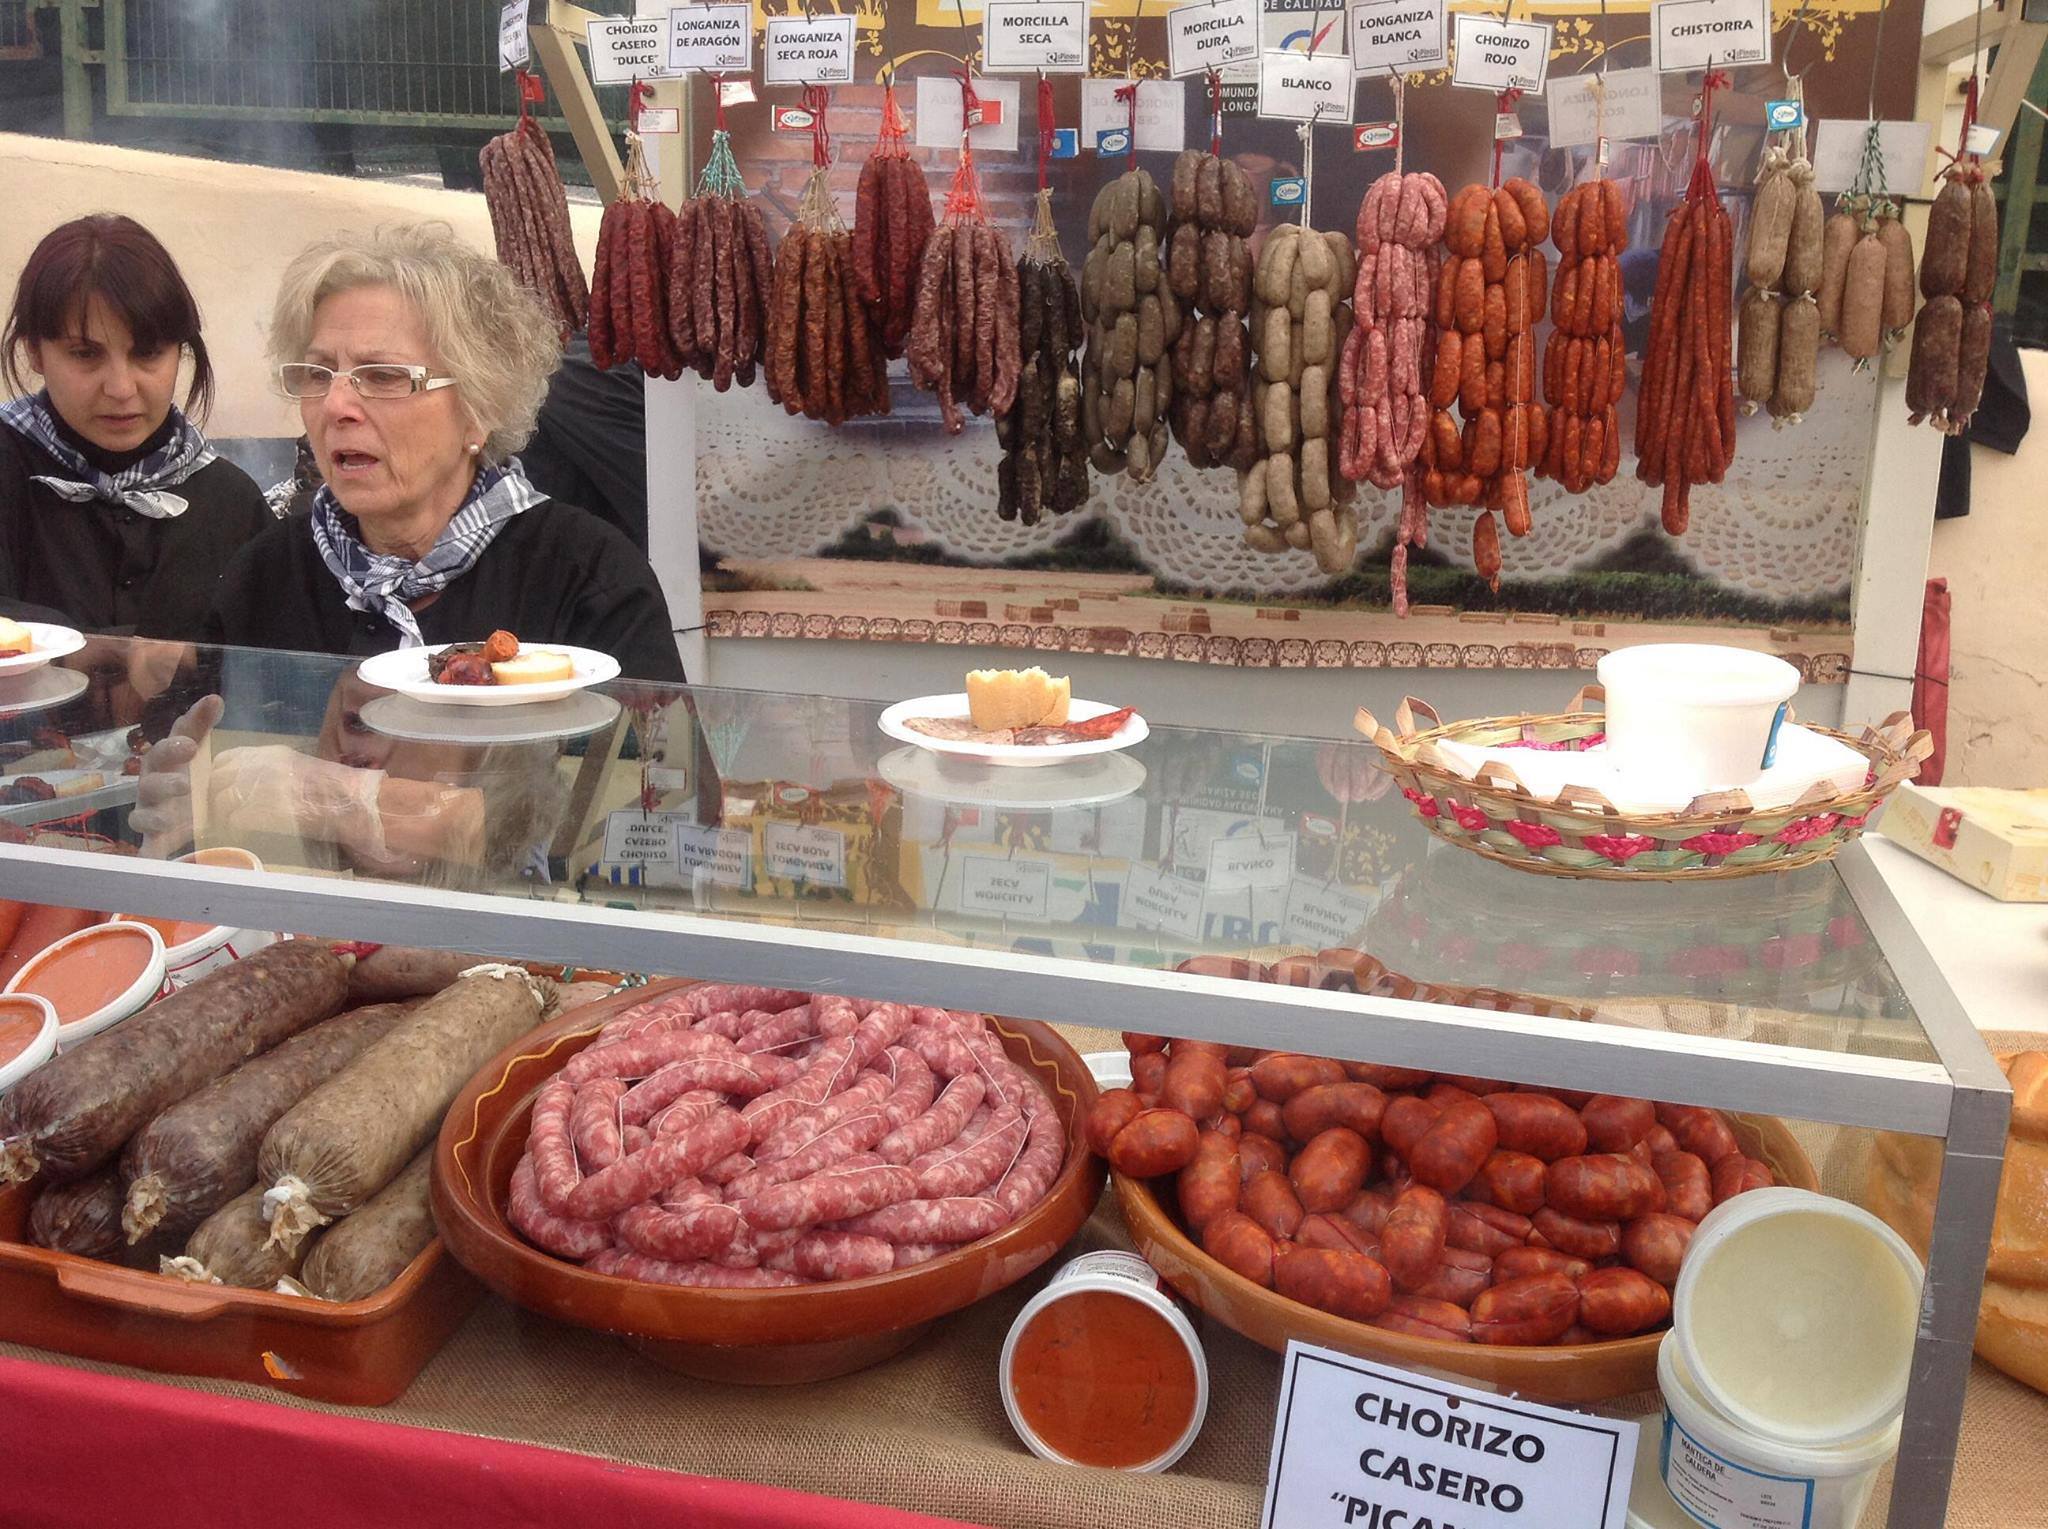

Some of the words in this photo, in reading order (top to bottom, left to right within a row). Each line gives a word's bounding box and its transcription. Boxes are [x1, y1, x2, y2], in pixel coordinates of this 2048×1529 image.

[677, 20, 741, 31] LONGANIZA
[1002, 16, 1069, 27] MORCILLA
[1183, 15, 1245, 36] MORCILLA
[1360, 10, 1434, 29] LONGANIZA
[606, 24, 658, 35] CHORIZO
[1671, 19, 1754, 37] CHISTORRA
[676, 37, 690, 47] DE
[691, 34, 740, 47] ARAGÓN
[774, 32, 843, 44] LONGANIZA
[1019, 33, 1052, 44] SECA
[1196, 35, 1231, 50] DURA
[1372, 29, 1422, 45] BLANCA
[1475, 34, 1530, 49] CHORIZO
[611, 39, 657, 51] CASERO
[777, 50, 806, 60] SECA
[808, 49, 838, 59] ROJA
[1484, 53, 1517, 66] ROJO
[1281, 77, 1332, 91] BLANCO
[1207, 87, 1259, 98] CMUNID
[1355, 1392, 1545, 1463] CHORIZO
[1681, 1438, 1713, 1469] MANTECA
[1714, 1461, 1726, 1474] DE
[1684, 1454, 1717, 1481] CALDERA
[1359, 1448, 1524, 1513] CASERO
